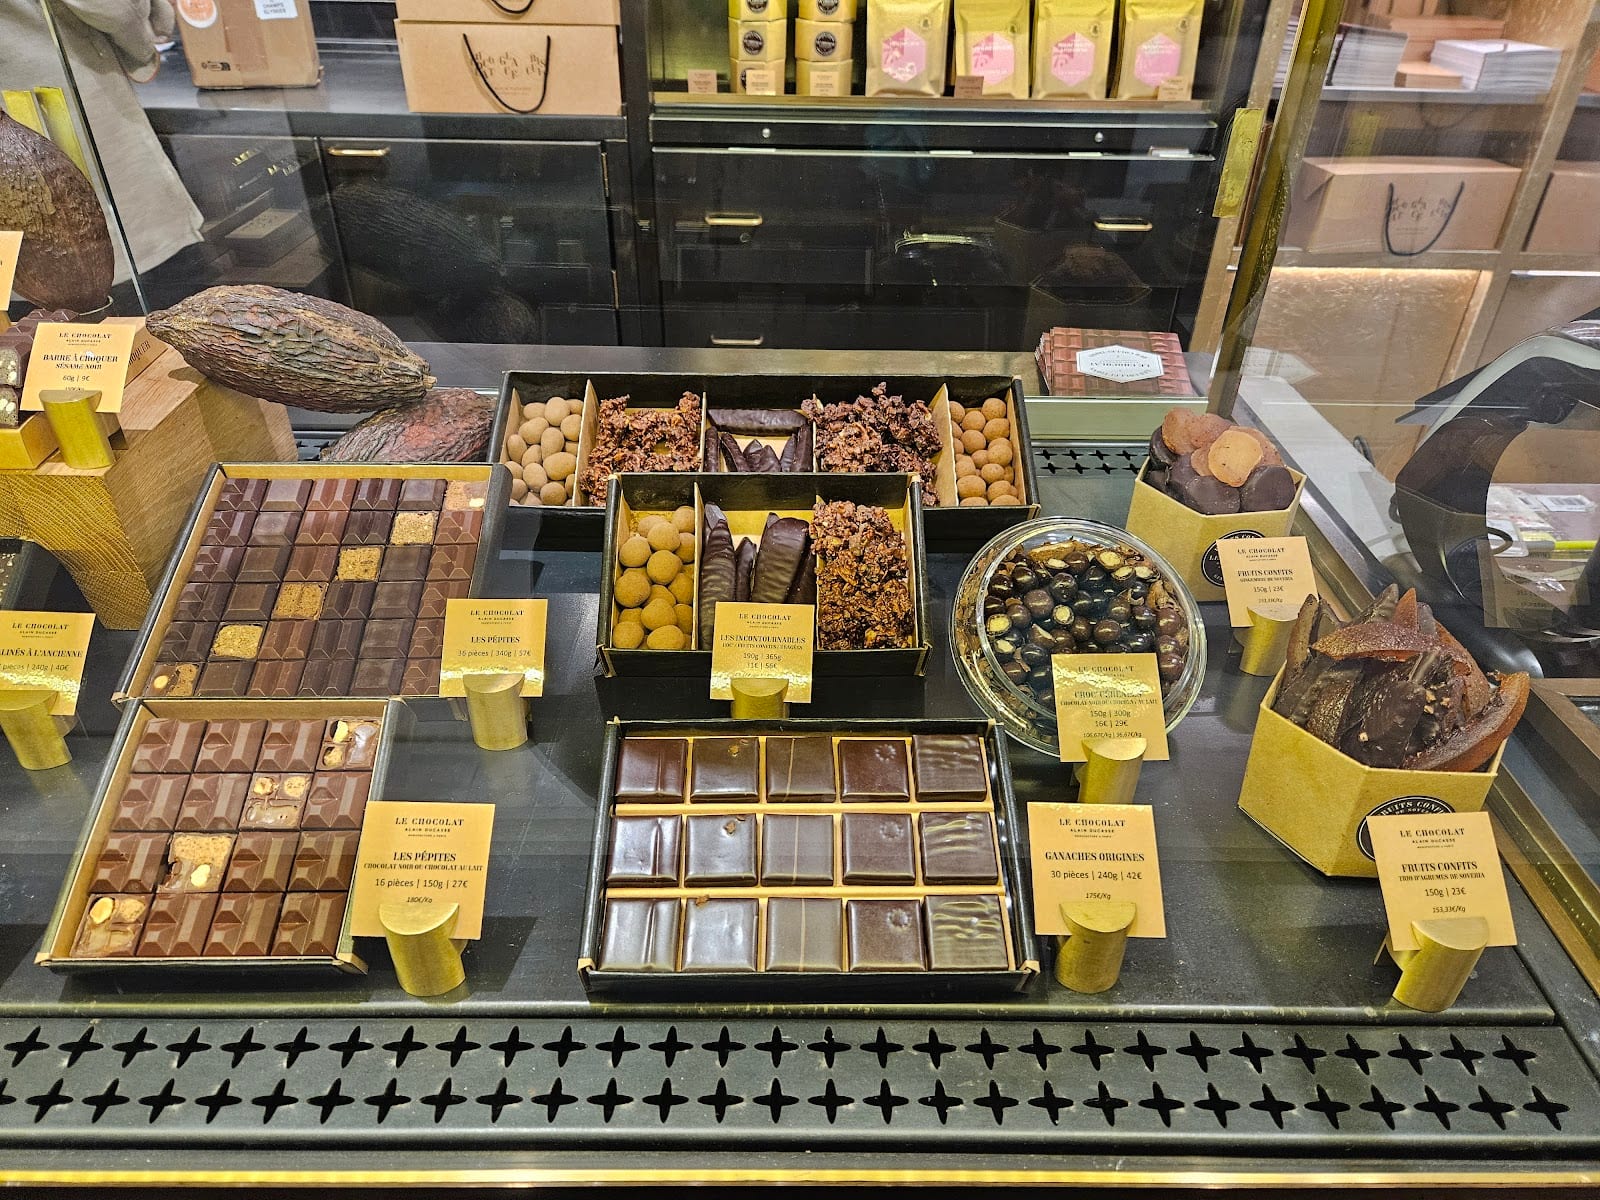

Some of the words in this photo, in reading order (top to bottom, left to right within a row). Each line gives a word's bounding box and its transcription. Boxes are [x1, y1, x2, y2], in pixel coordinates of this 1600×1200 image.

[43, 354, 71, 362] BARRE
[79, 354, 118, 363] CROQUER
[488, 635, 520, 643] PÉPITES
[736, 635, 806, 643] INCONTOURNABLES
[0, 648, 25, 656] LINÉS
[34, 649, 82, 658] L'ANCIENNE
[766, 653, 782, 662] 365g
[395, 817, 408, 825] LE
[412, 818, 465, 826] CHOCOLAT
[1059, 818, 1071, 826] LE
[1075, 818, 1125, 827] CHOCOLAT
[1400, 830, 1413, 838] LE
[1415, 828, 1465, 837] CHOCOLAT
[393, 852, 412, 861] LES
[414, 851, 456, 862] PÉPITES
[1045, 851, 1097, 861] GANACHES
[1099, 852, 1145, 862] ORIGINES
[1401, 862, 1436, 873] FRUITS
[1437, 861, 1478, 871] CONFITS
[1051, 870, 1061, 879] 30
[1064, 871, 1089, 880] pièces
[1097, 871, 1118, 881] 240g
[1126, 871, 1142, 880] 42€
[375, 878, 385, 887] 16
[387, 878, 413, 888] pièces
[423, 879, 443, 889] 150g
[452, 880, 468, 888] 27€
[1085, 892, 1111, 900] 175€/Kg
[1425, 888, 1444, 898] 150g
[1452, 887, 1467, 896] 23€
